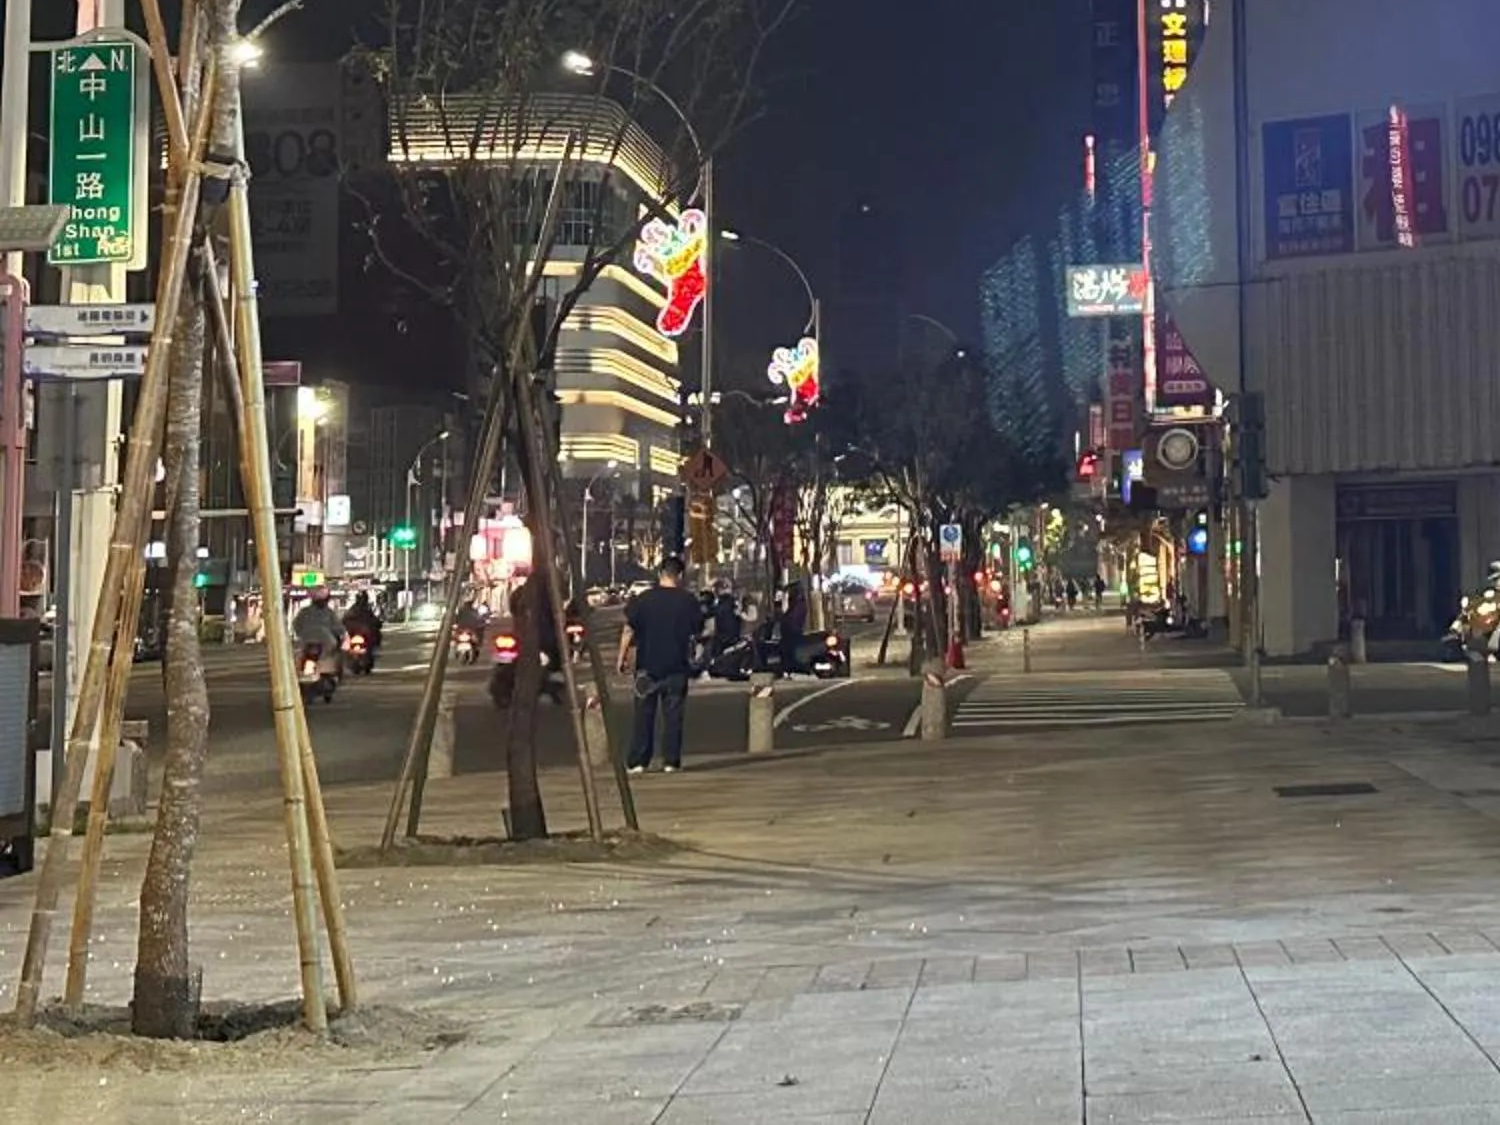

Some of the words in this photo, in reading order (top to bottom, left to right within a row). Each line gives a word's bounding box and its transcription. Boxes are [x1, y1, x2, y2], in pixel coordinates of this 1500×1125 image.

[57, 50, 77, 73] 北
[75, 71, 108, 200] 中山一路
[66, 205, 121, 223] hong
[65, 224, 116, 242] Shan
[55, 242, 80, 258] 1st
